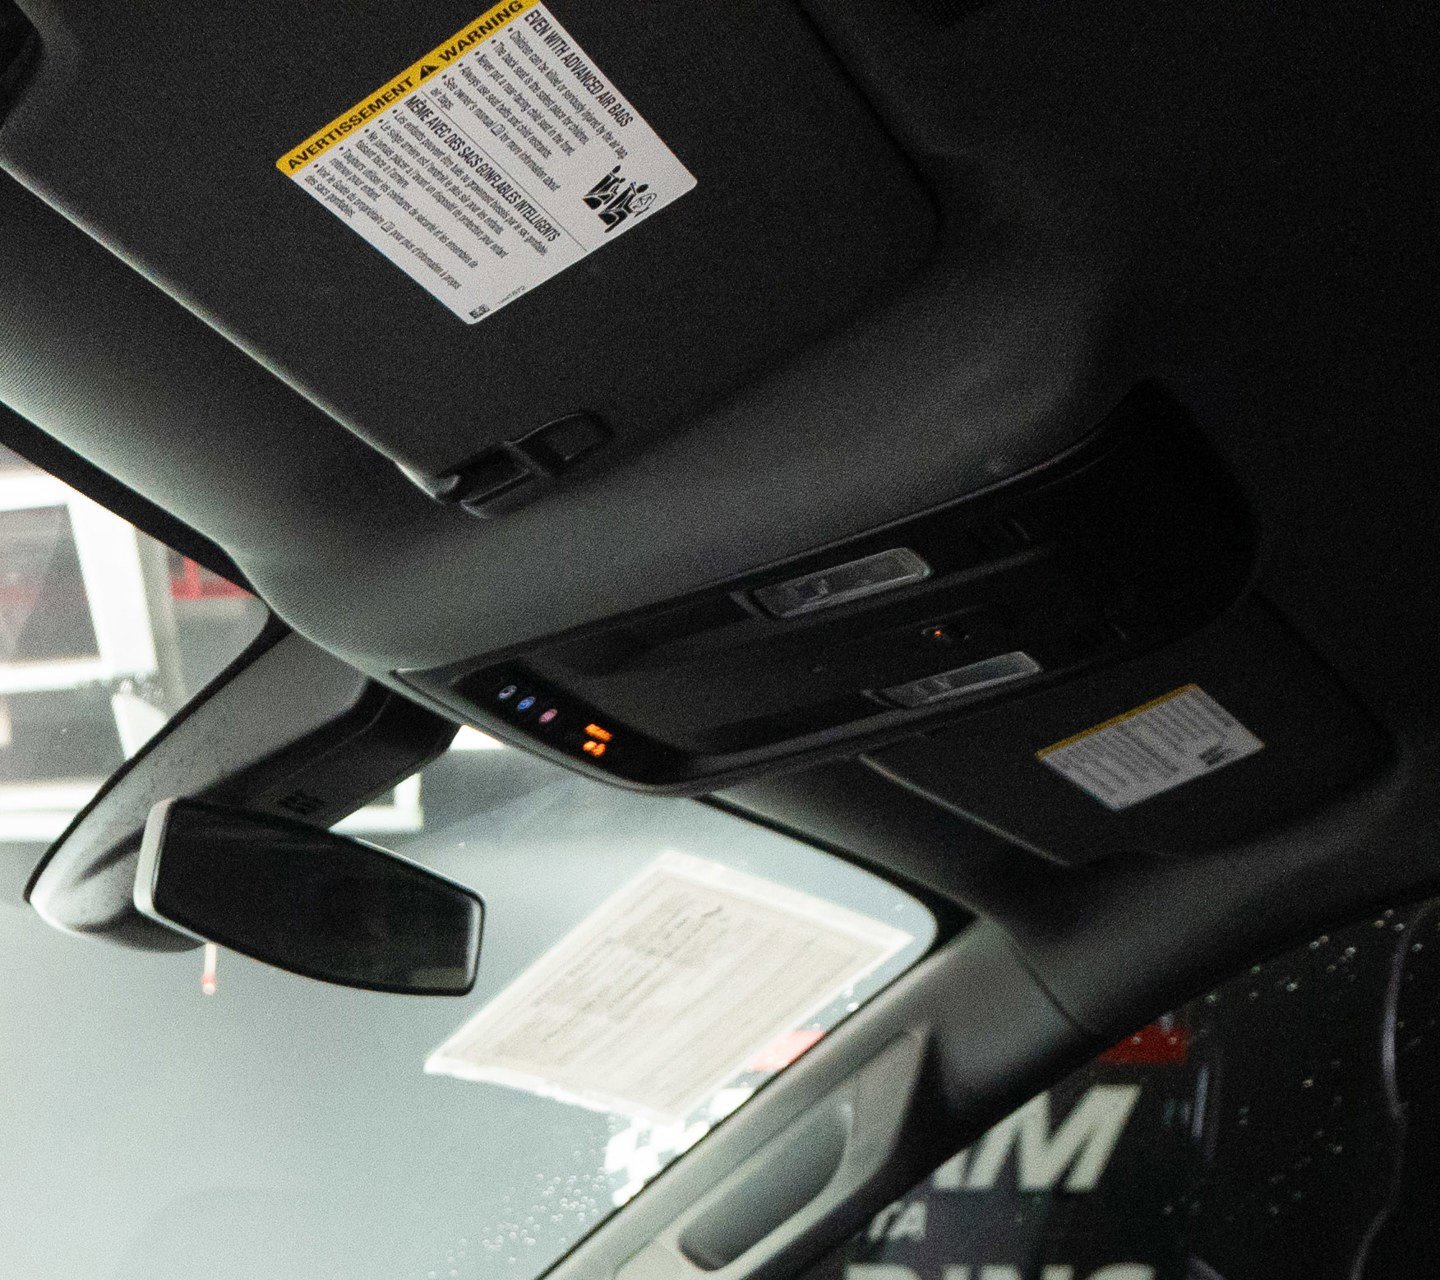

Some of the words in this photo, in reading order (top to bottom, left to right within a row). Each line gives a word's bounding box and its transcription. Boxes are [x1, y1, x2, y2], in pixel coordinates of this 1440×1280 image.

[439, 2, 524, 63] WARNING
[524, 10, 551, 34] EVEN
[543, 30, 570, 55] WITH
[562, 51, 604, 94] ADVANCED
[596, 90, 616, 107] AIR
[608, 103, 633, 126] BAGS
[287, 77, 414, 170] AVERTISSEMENT
[426, 116, 451, 137] AVEC
[444, 133, 464, 150] DES
[457, 146, 482, 167] SACS
[475, 162, 520, 203] GONFLABLES
[513, 199, 560, 241] INTELLIGENTS
